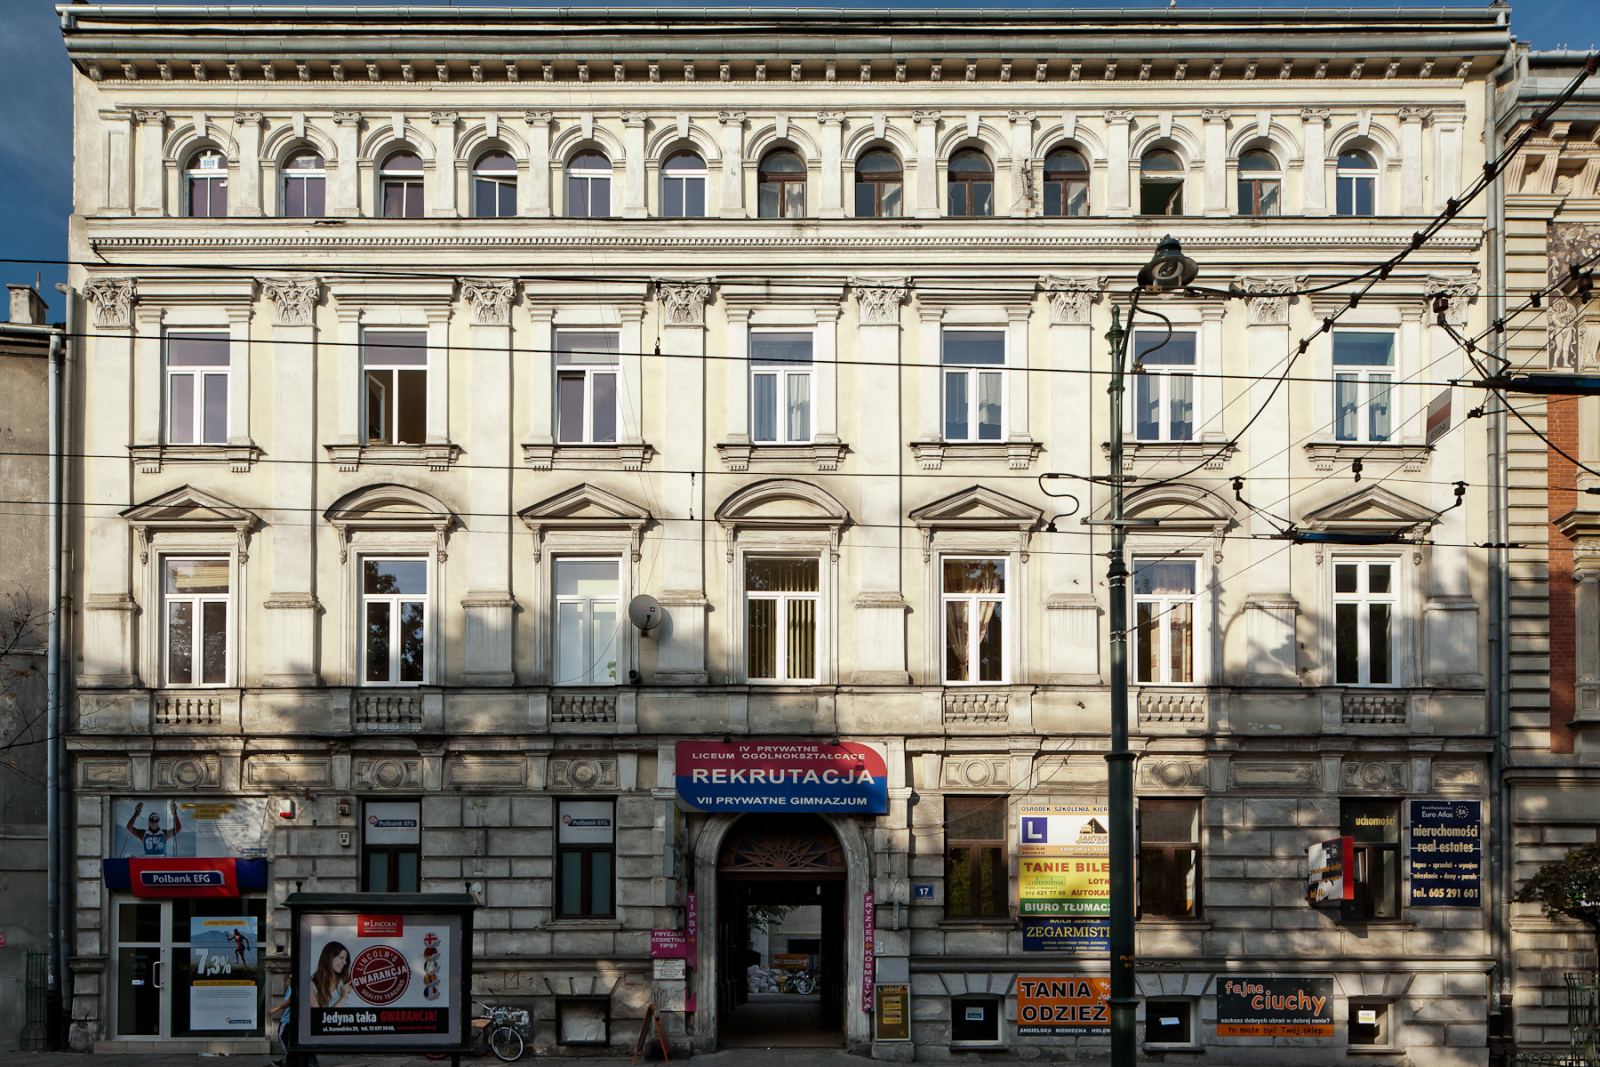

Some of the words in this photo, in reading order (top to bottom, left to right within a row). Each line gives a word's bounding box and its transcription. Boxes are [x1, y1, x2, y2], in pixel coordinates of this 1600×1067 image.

[692, 752, 735, 760] LICEUM
[742, 751, 866, 761] OGÓLNOKSZTAŁCĄCE
[756, 745, 818, 753] PRYWATNE
[692, 768, 875, 785] REKRUTACJA
[697, 796, 713, 805] VII
[716, 796, 787, 806] PRYWATNE
[790, 796, 868, 806] GIMNAZJUM
[1027, 821, 1043, 839] L
[1413, 823, 1478, 837] nieruchomości
[146, 836, 164, 851] 6%
[1417, 839, 1436, 852] real
[1439, 842, 1474, 853] estates
[1024, 862, 1070, 872] TANIE
[153, 874, 192, 884] Polbank
[193, 874, 210, 883] EFG
[919, 887, 929, 896] 17
[1413, 887, 1428, 898] tel.
[1428, 888, 1445, 898] 605
[1445, 888, 1461, 898] 291
[1463, 888, 1479, 898] 601
[1024, 902, 1060, 912] BIURO
[688, 895, 696, 936] TIPSY
[865, 895, 873, 942] FRYZJER
[193, 948, 232, 977] 7,3%
[353, 965, 408, 987] GWARANCJA
[863, 949, 873, 1010] KOSMETYKA
[1021, 981, 1092, 998] TANIA
[1225, 980, 1264, 997] fajne
[1251, 989, 1327, 1017] ciuchy
[322, 1011, 355, 1026] Jedyna
[355, 1010, 377, 1023] taka
[380, 1010, 438, 1023] GWARANCJA!
[1021, 1001, 1108, 1022] ODZIEŻ
[1292, 1017, 1310, 1025] dobrej
[1264, 1026, 1275, 1034] być
[1281, 1026, 1300, 1035] Twój
[1303, 1026, 1324, 1035] sklep
